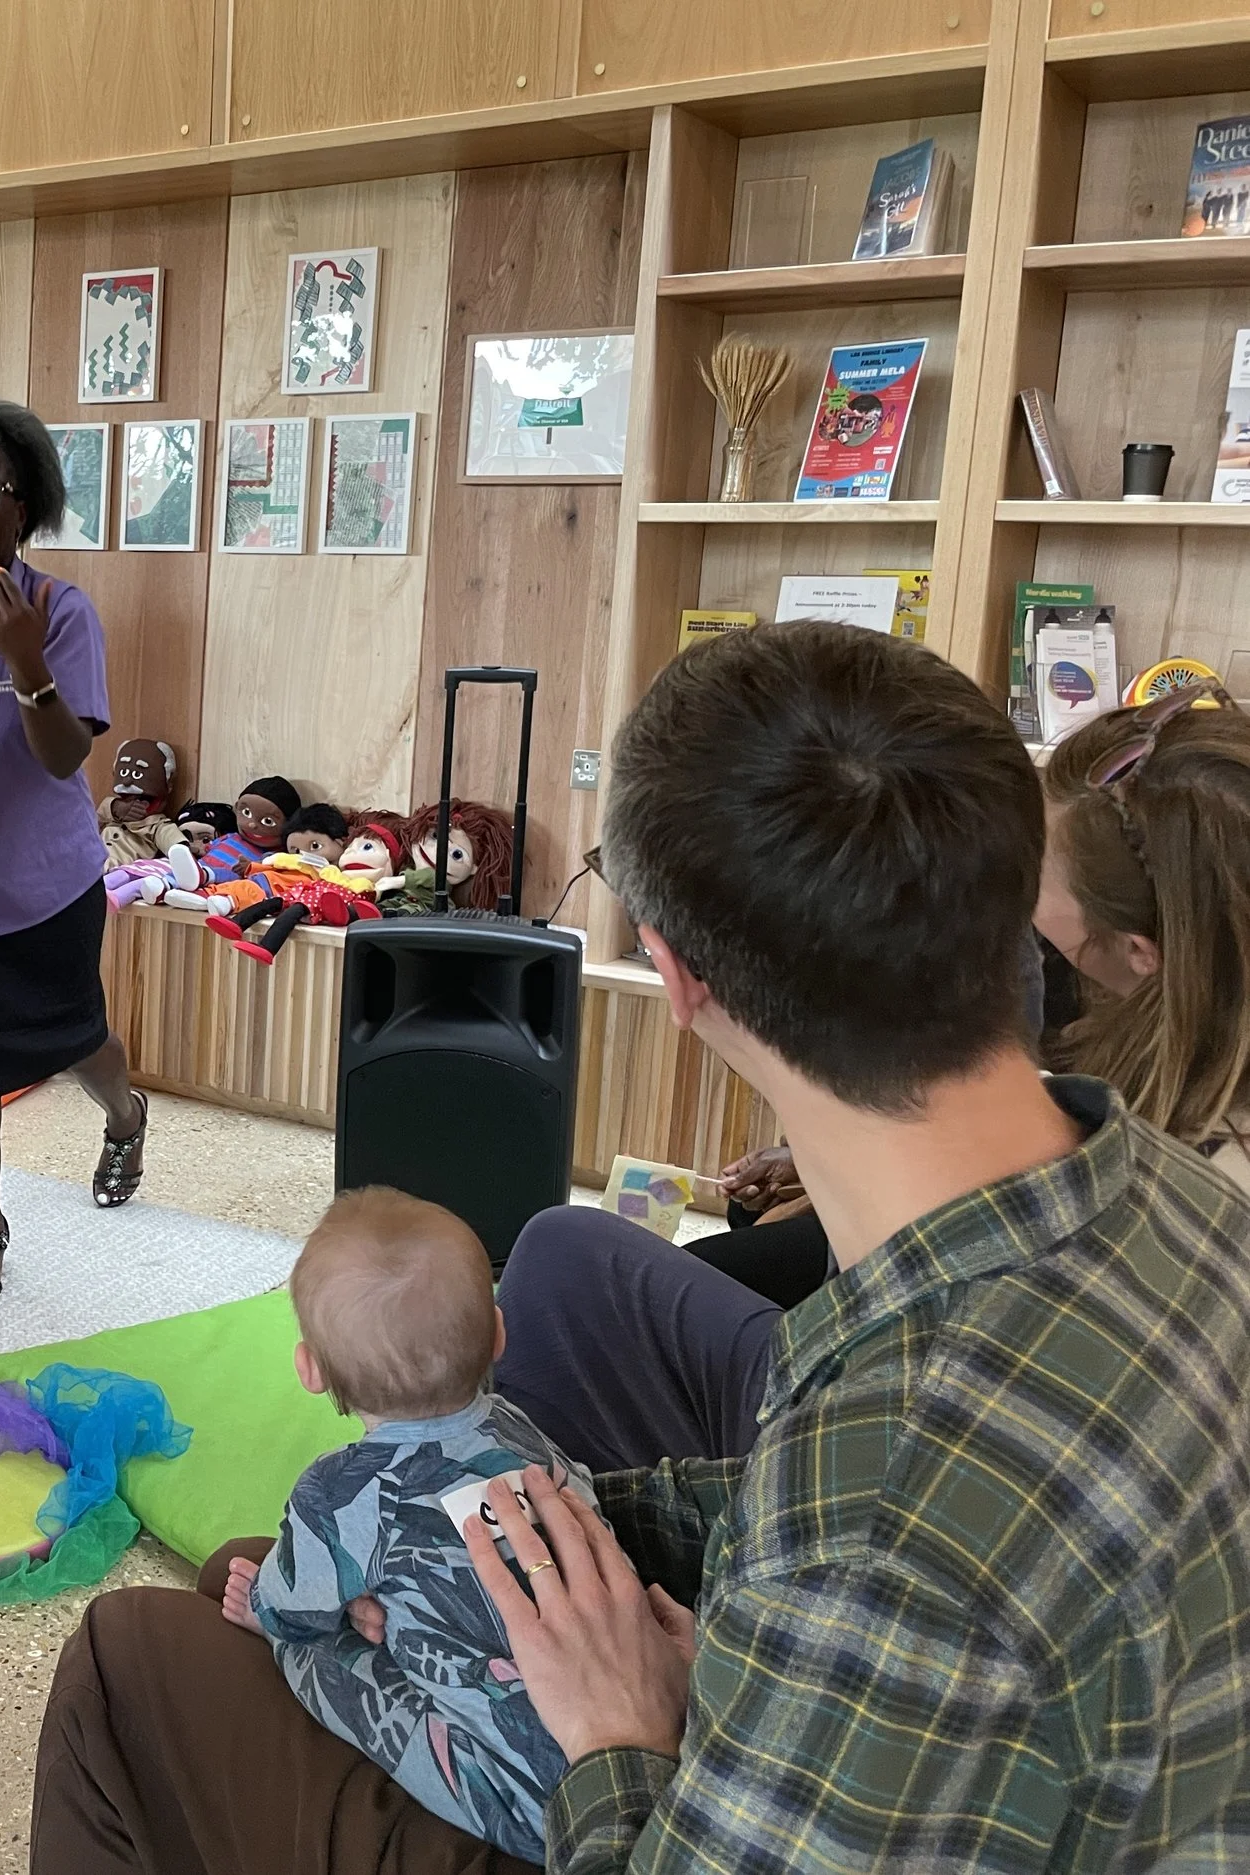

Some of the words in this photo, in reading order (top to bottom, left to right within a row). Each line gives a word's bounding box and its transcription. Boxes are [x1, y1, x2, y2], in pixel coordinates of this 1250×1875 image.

[860, 358, 887, 367] FAMILY
[839, 368, 879, 380] SUMMER
[880, 365, 906, 377] MELA
[1051, 589, 1082, 600] walking
